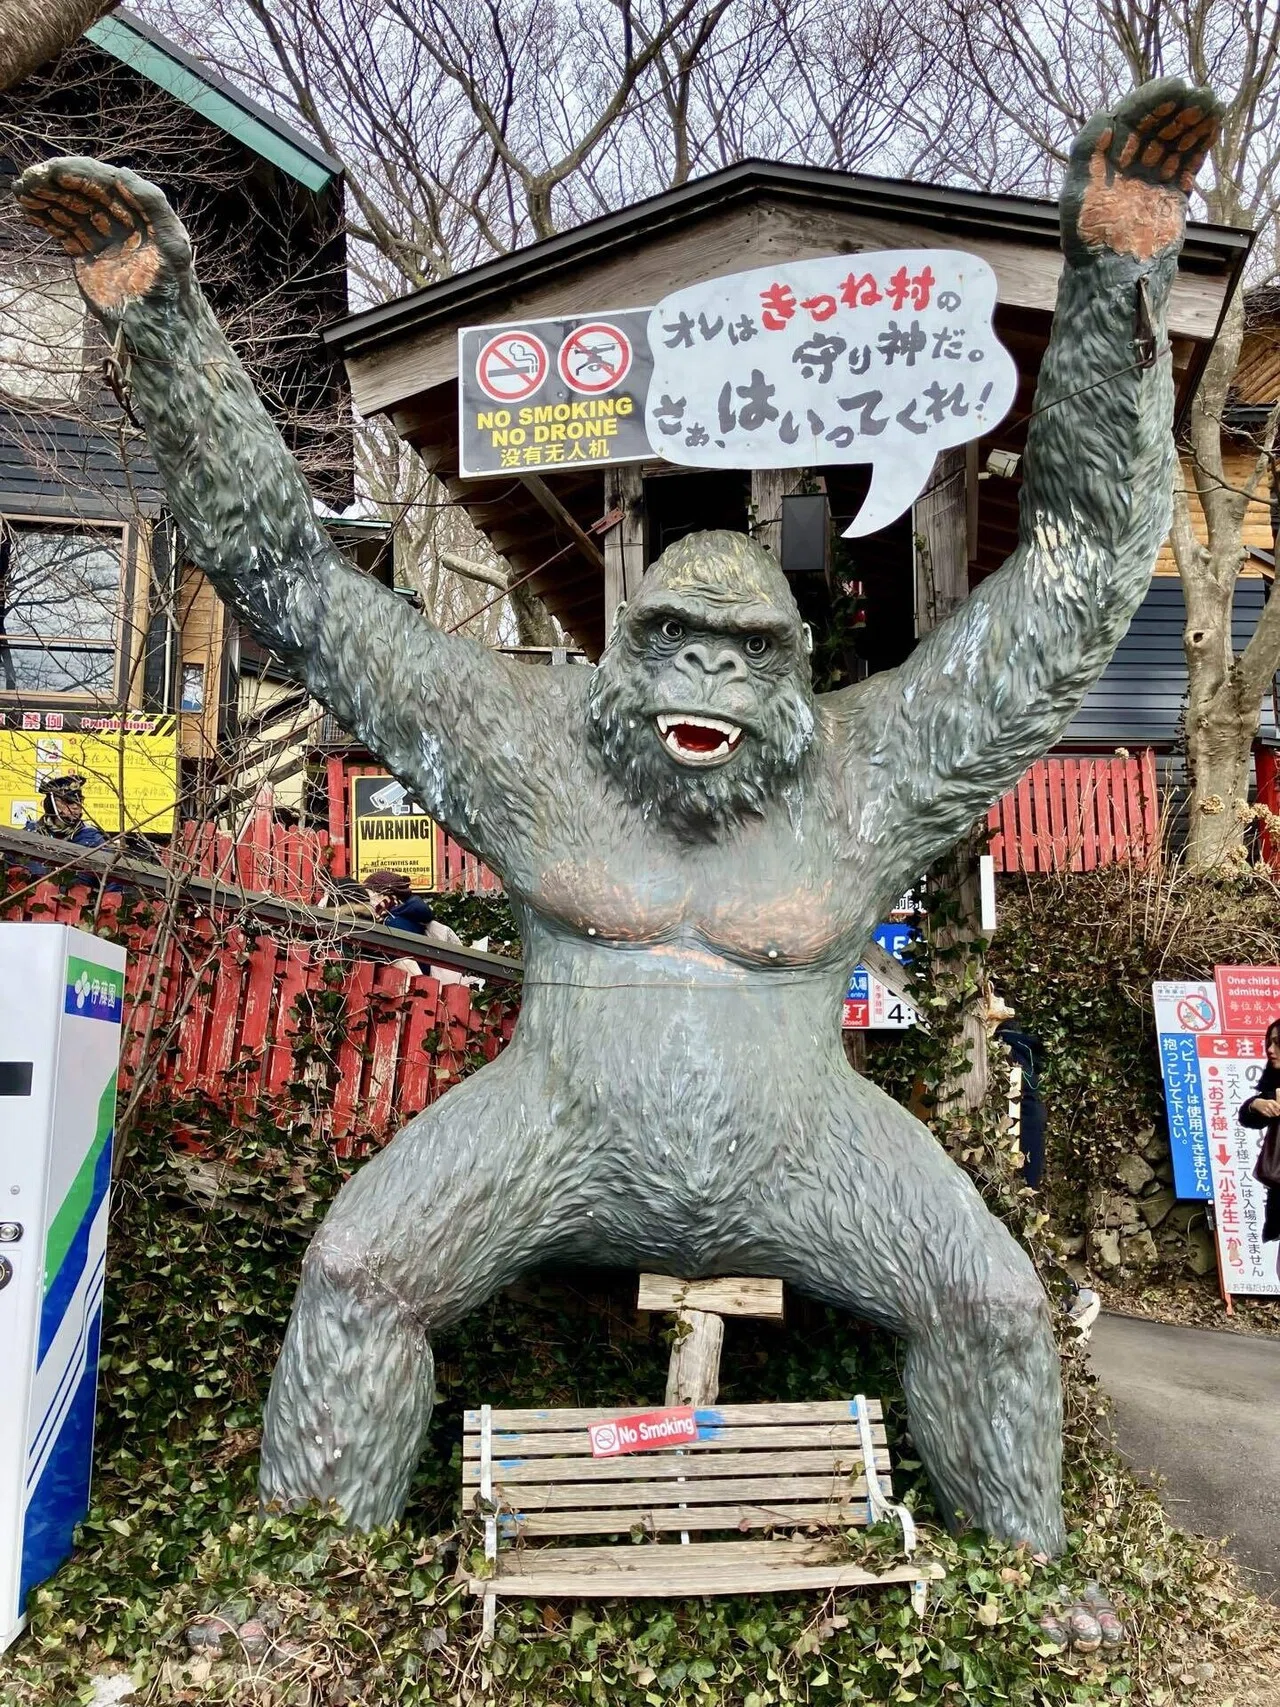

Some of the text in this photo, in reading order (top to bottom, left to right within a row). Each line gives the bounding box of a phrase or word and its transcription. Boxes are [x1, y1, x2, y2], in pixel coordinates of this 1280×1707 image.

[662, 265, 961, 348] オレはきつね村の
[792, 319, 985, 384] 守り神だ。
[477, 397, 633, 430] NO SMOKING
[492, 418, 618, 448] NO DRONE
[501, 439, 609, 468] 没有无人机
[81, 717, 156, 731] Prohibtions
[360, 819, 430, 841] WARNING
[1227, 976, 1246, 985] One
[1248, 975, 1270, 985] child
[1229, 987, 1271, 997] admitted
[850, 991, 866, 999] entry
[1213, 1038, 1267, 1057] ご注
[1163, 1038, 1188, 1145] 抱っこして下さい。
[1180, 1038, 1212, 1197] ベビーカーは使用できません。
[617, 1417, 695, 1445] No Smoking
